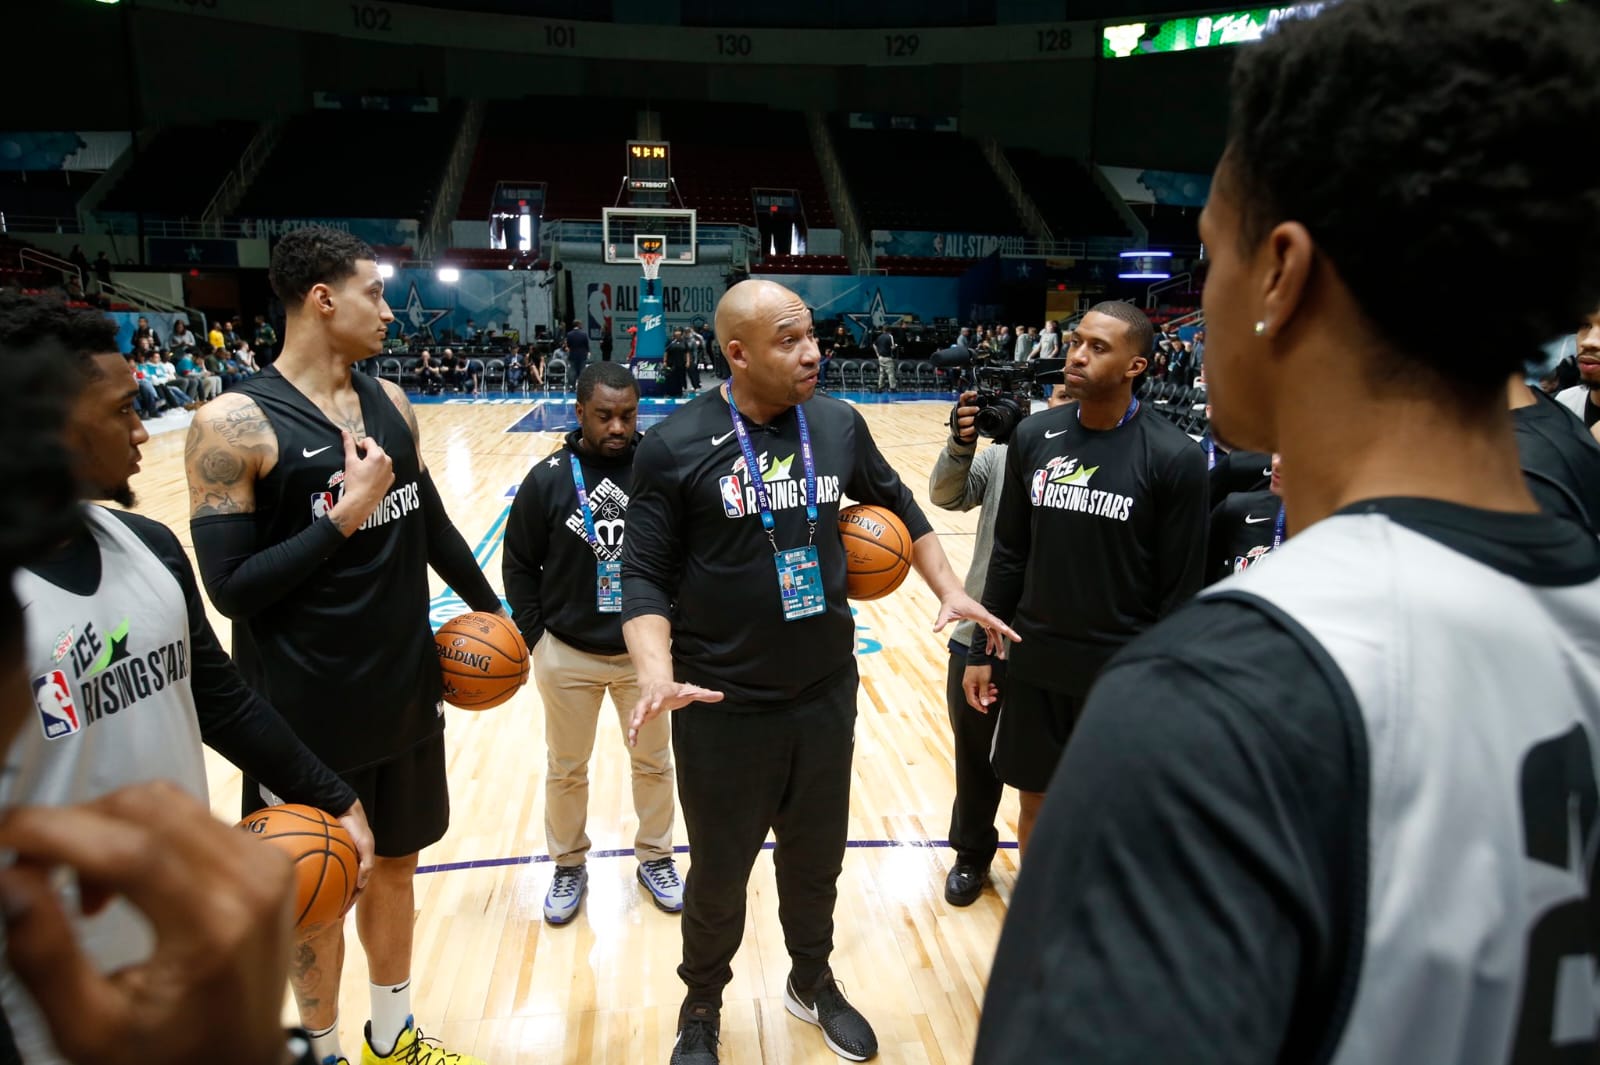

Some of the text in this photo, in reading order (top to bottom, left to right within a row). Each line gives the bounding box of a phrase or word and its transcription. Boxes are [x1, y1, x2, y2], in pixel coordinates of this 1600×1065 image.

[351, 6, 391, 31] 102
[545, 25, 575, 49] 101
[717, 34, 751, 56] 130
[886, 35, 919, 57] 129
[1037, 29, 1072, 51] 128
[615, 285, 714, 313] ALL AR 2019
[644, 314, 662, 331] ICE
[1047, 458, 1079, 481] ICE
[799, 475, 840, 507] SARS
[1043, 483, 1134, 522] RISING STARS
[70, 621, 103, 680] ICE
[80, 656, 153, 727] RISING
